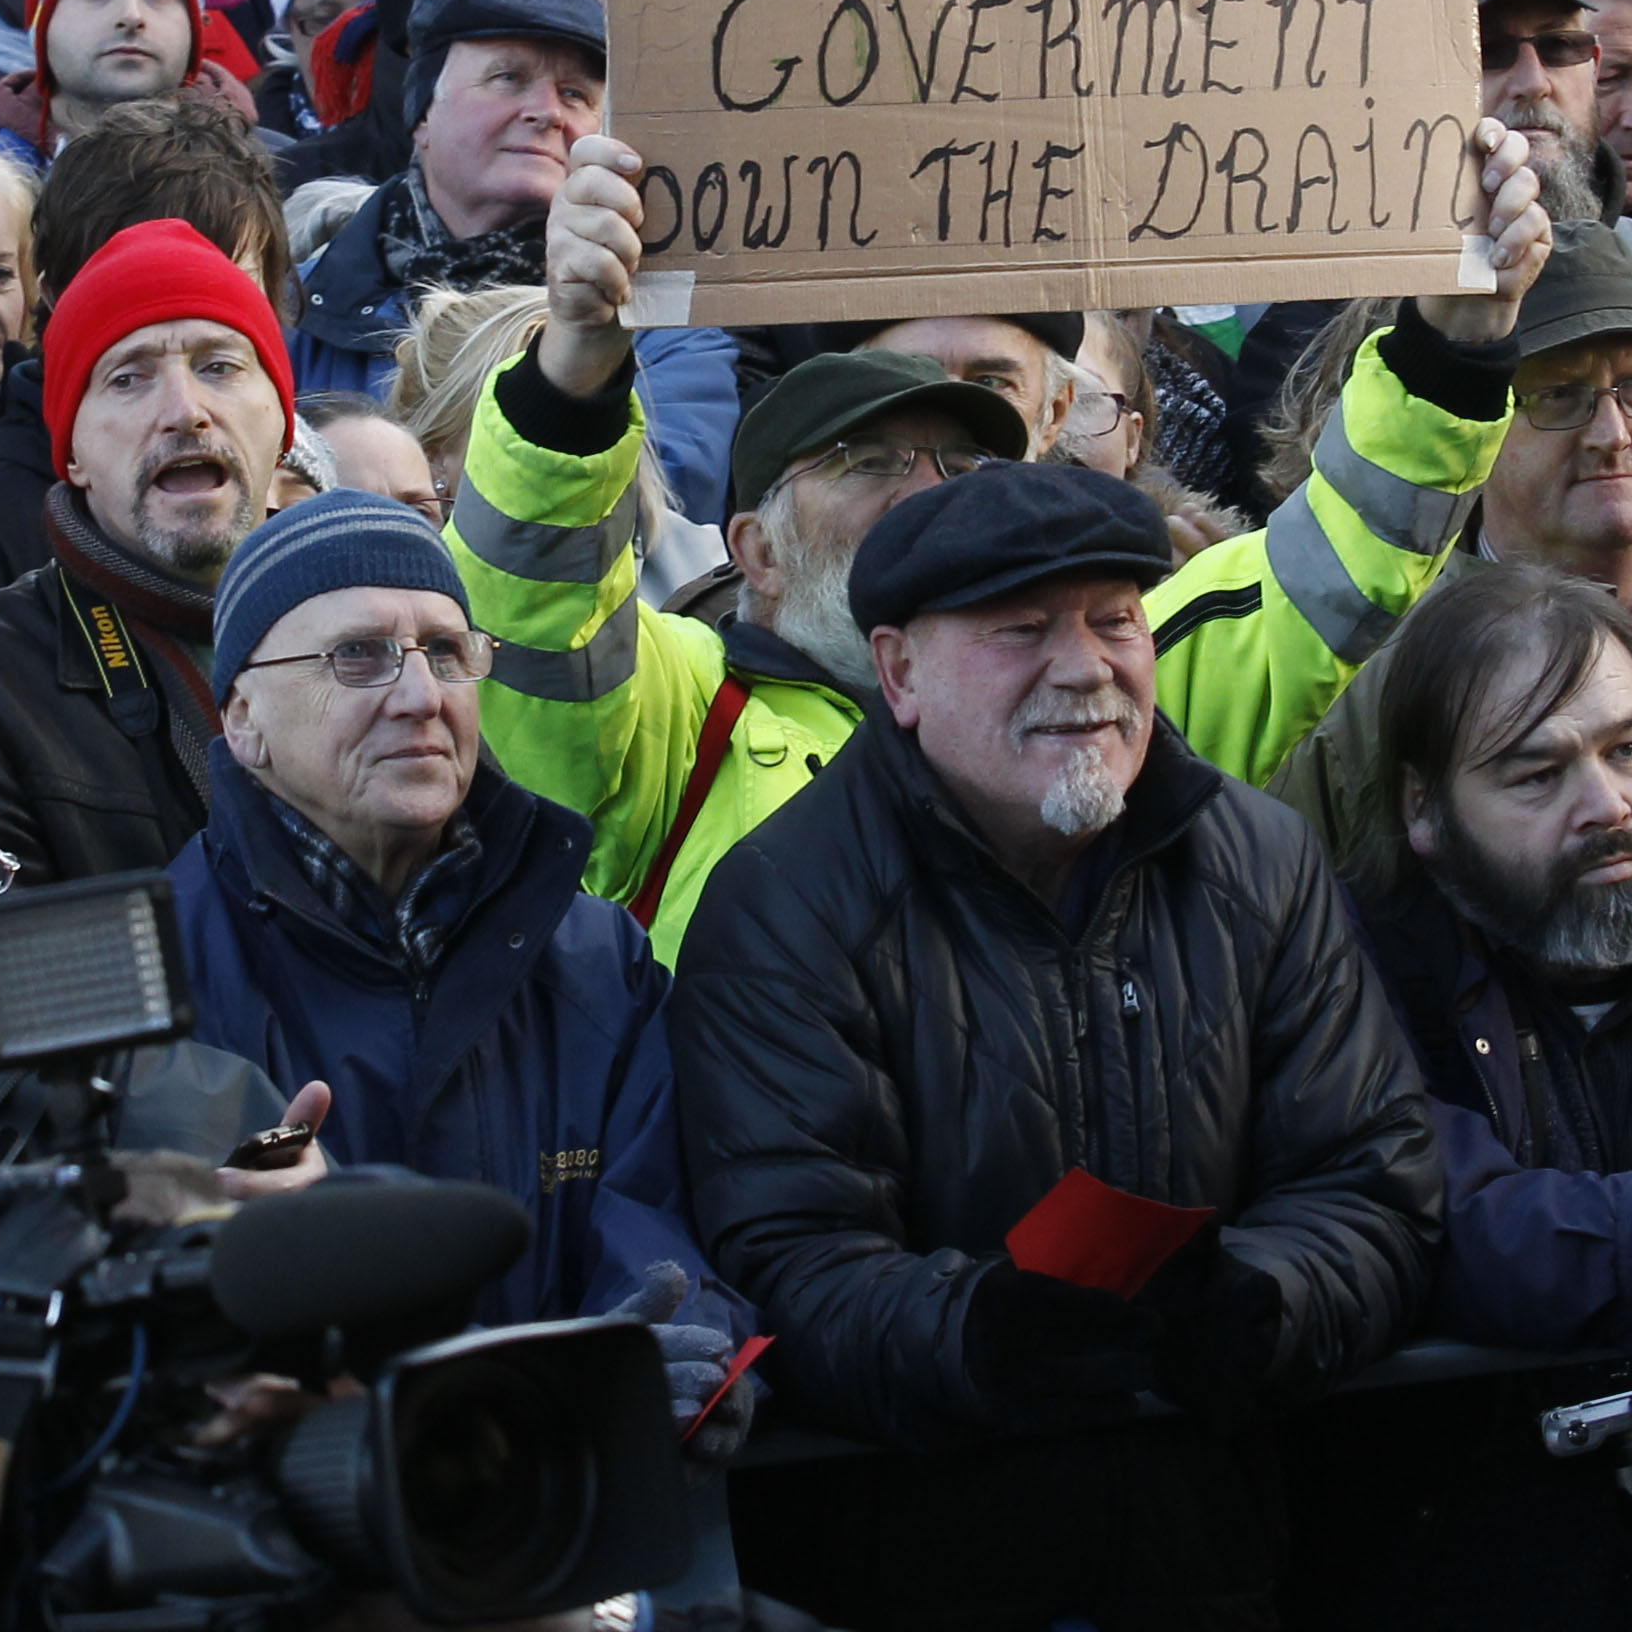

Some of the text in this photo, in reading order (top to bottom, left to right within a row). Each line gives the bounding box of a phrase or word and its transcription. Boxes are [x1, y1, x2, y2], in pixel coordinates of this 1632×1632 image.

[639, 155, 879, 252] DOWN
[909, 138, 1086, 248] THE
[91, 605, 130, 668] Nikon
